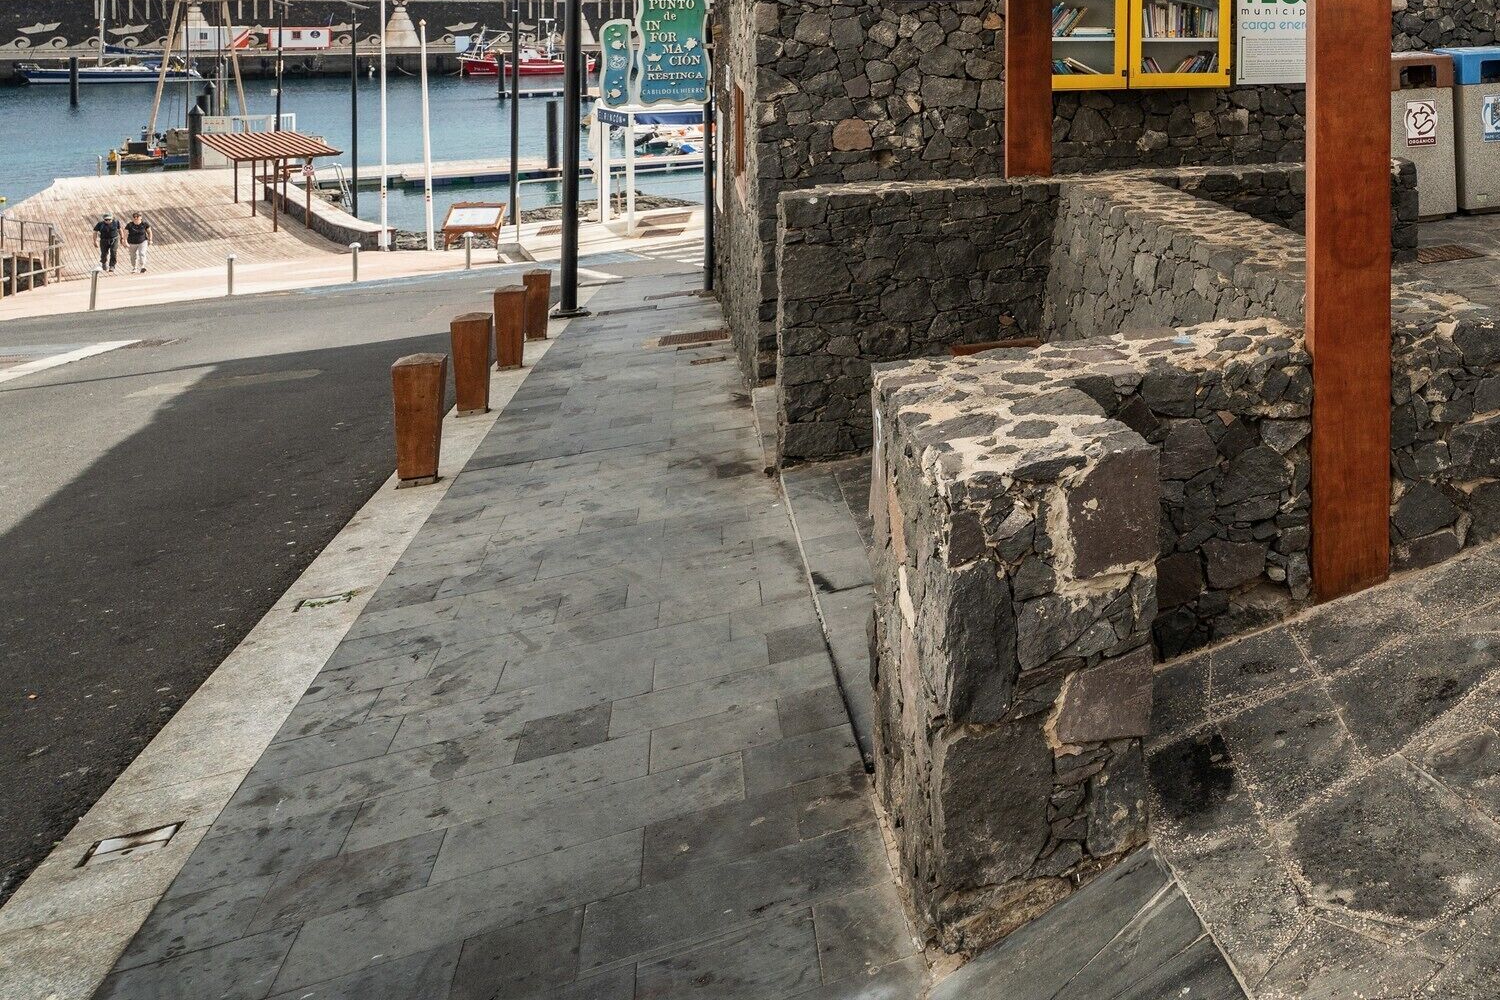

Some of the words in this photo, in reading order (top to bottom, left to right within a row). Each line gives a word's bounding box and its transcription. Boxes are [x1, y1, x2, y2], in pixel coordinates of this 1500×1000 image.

[663, 11, 677, 21] de
[645, 20, 661, 31] IN
[1241, 21, 1276, 32] carga
[1279, 21, 1307, 30] ener
[650, 31, 677, 42] FOR
[662, 43, 684, 54] MA
[669, 52, 701, 66] CIÓN
[647, 64, 663, 72] LA
[647, 71, 704, 80] RESTINGA
